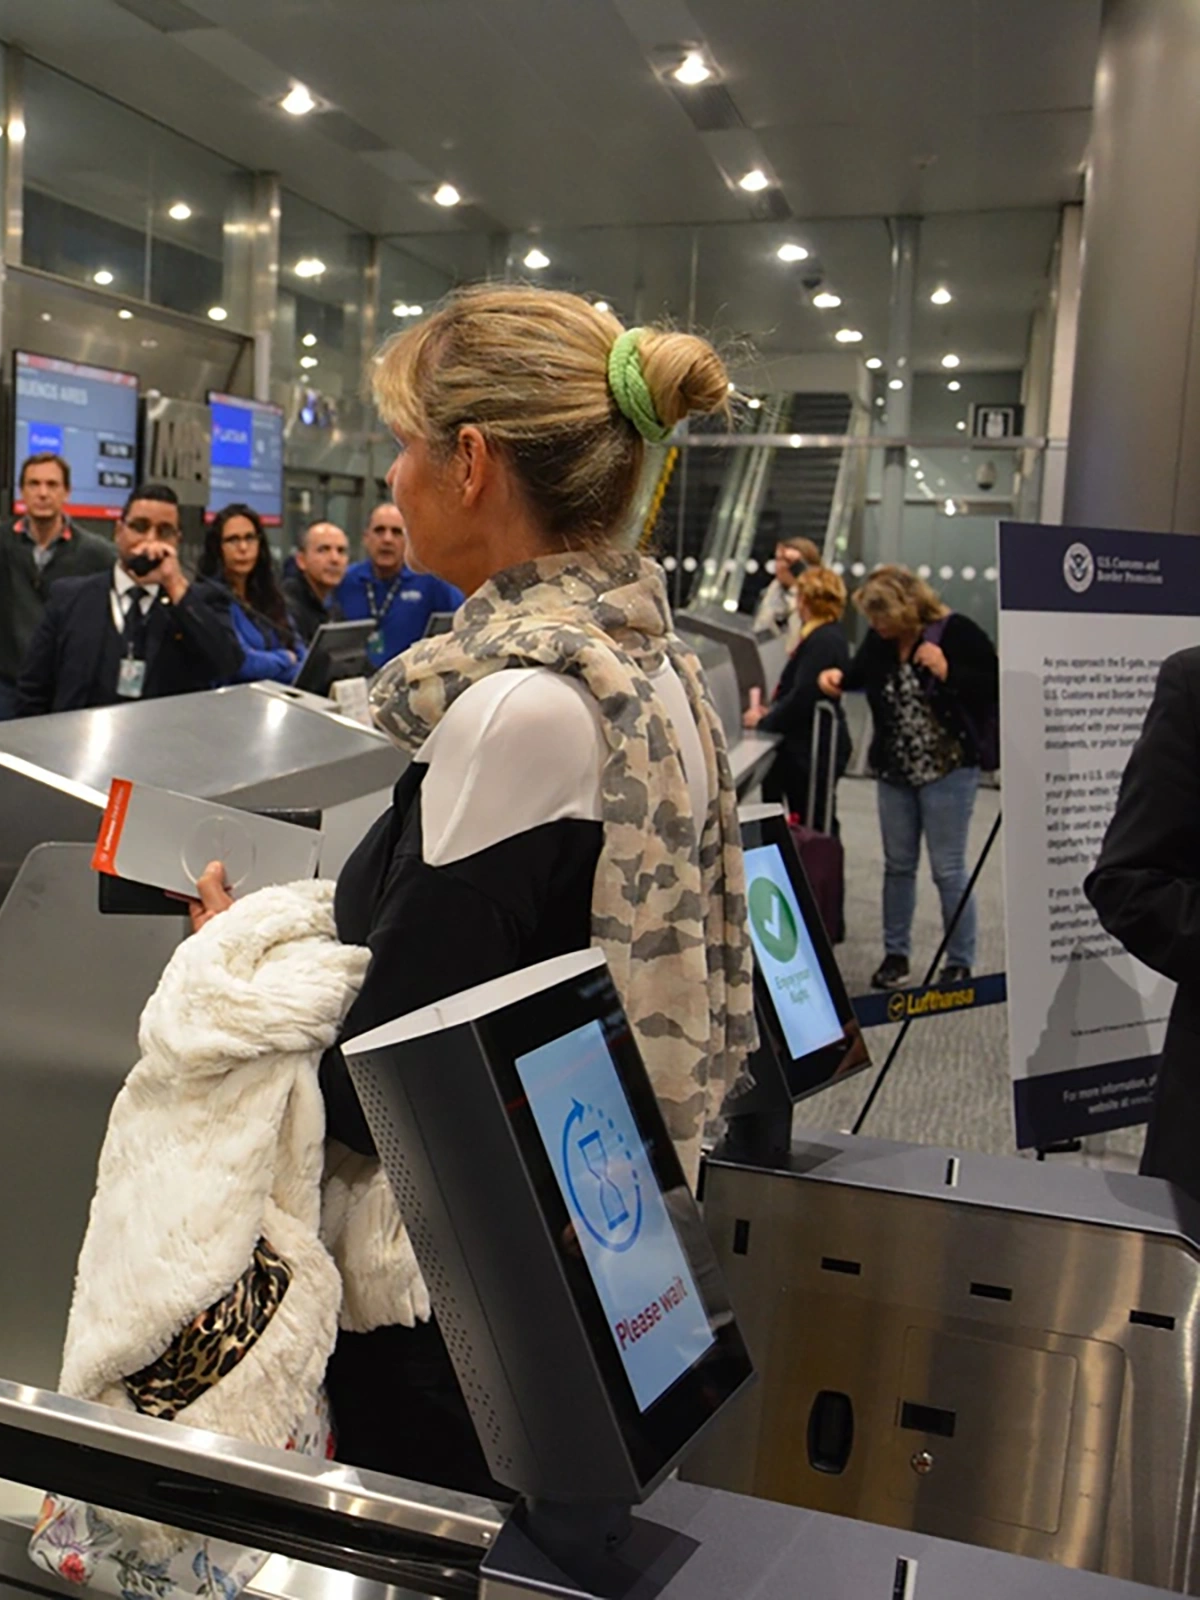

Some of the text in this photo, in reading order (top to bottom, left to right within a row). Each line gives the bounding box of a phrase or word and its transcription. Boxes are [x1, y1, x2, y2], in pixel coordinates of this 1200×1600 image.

[1112, 556, 1144, 570] Customs
[1097, 569, 1123, 582] Border
[906, 988, 975, 1016] Lufthansa
[614, 1276, 689, 1352] Please wait
